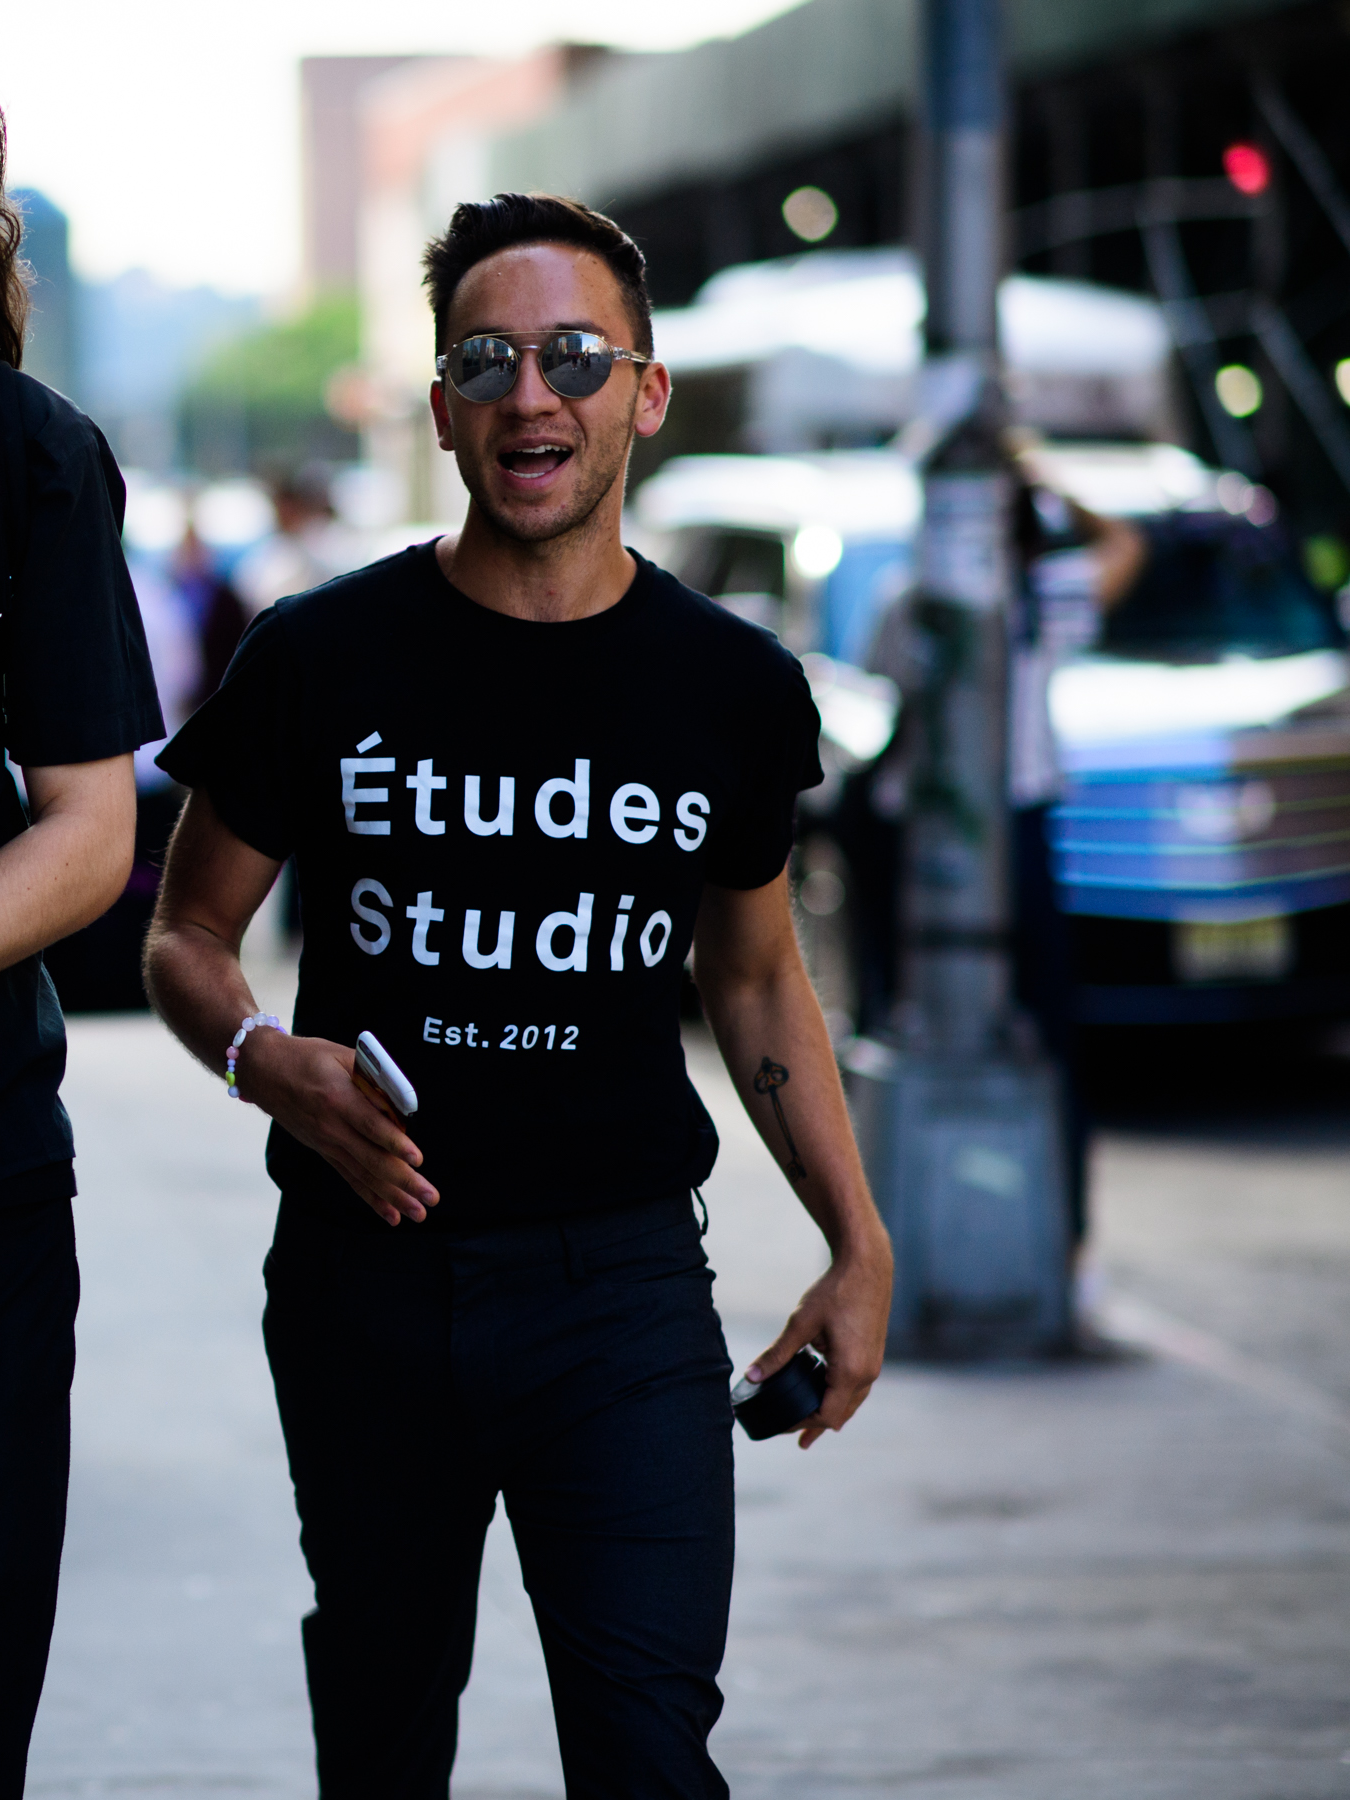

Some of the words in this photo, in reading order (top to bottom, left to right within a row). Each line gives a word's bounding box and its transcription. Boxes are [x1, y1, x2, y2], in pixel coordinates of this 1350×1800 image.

[340, 730, 711, 852] Études
[349, 877, 672, 972] Studio
[422, 1016, 489, 1048] Est.
[499, 1024, 579, 1050] 2012
